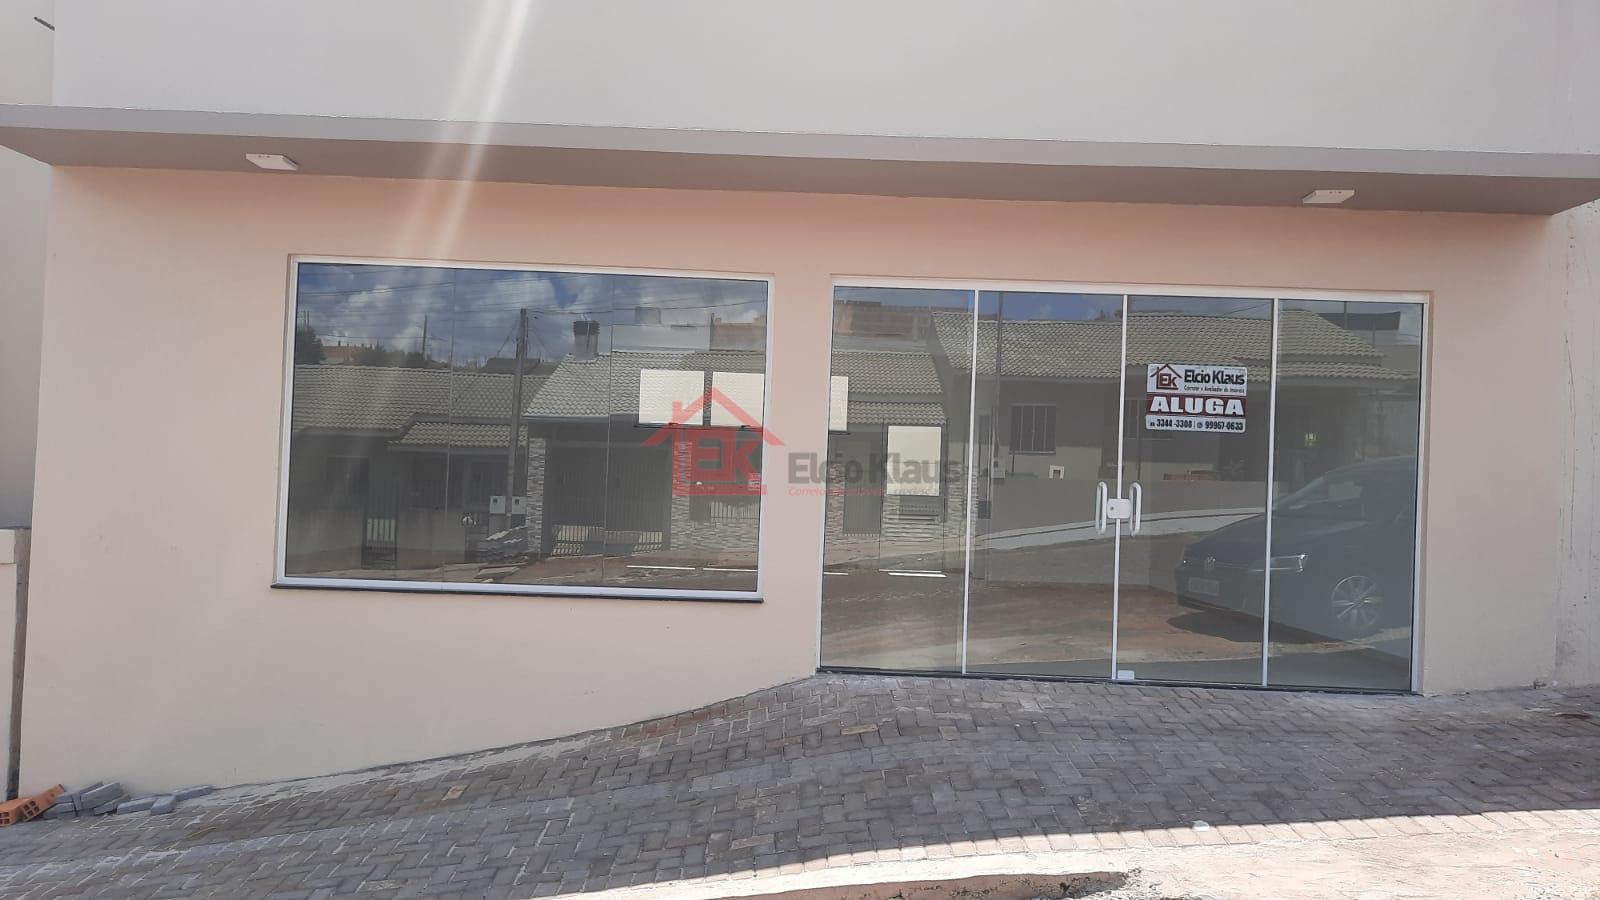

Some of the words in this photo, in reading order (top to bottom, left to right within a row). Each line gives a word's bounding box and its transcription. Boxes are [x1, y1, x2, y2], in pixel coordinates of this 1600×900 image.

[1184, 369, 1211, 384] Elcio
[1213, 370, 1245, 385] Klaus
[1149, 396, 1244, 416] ALUGA
